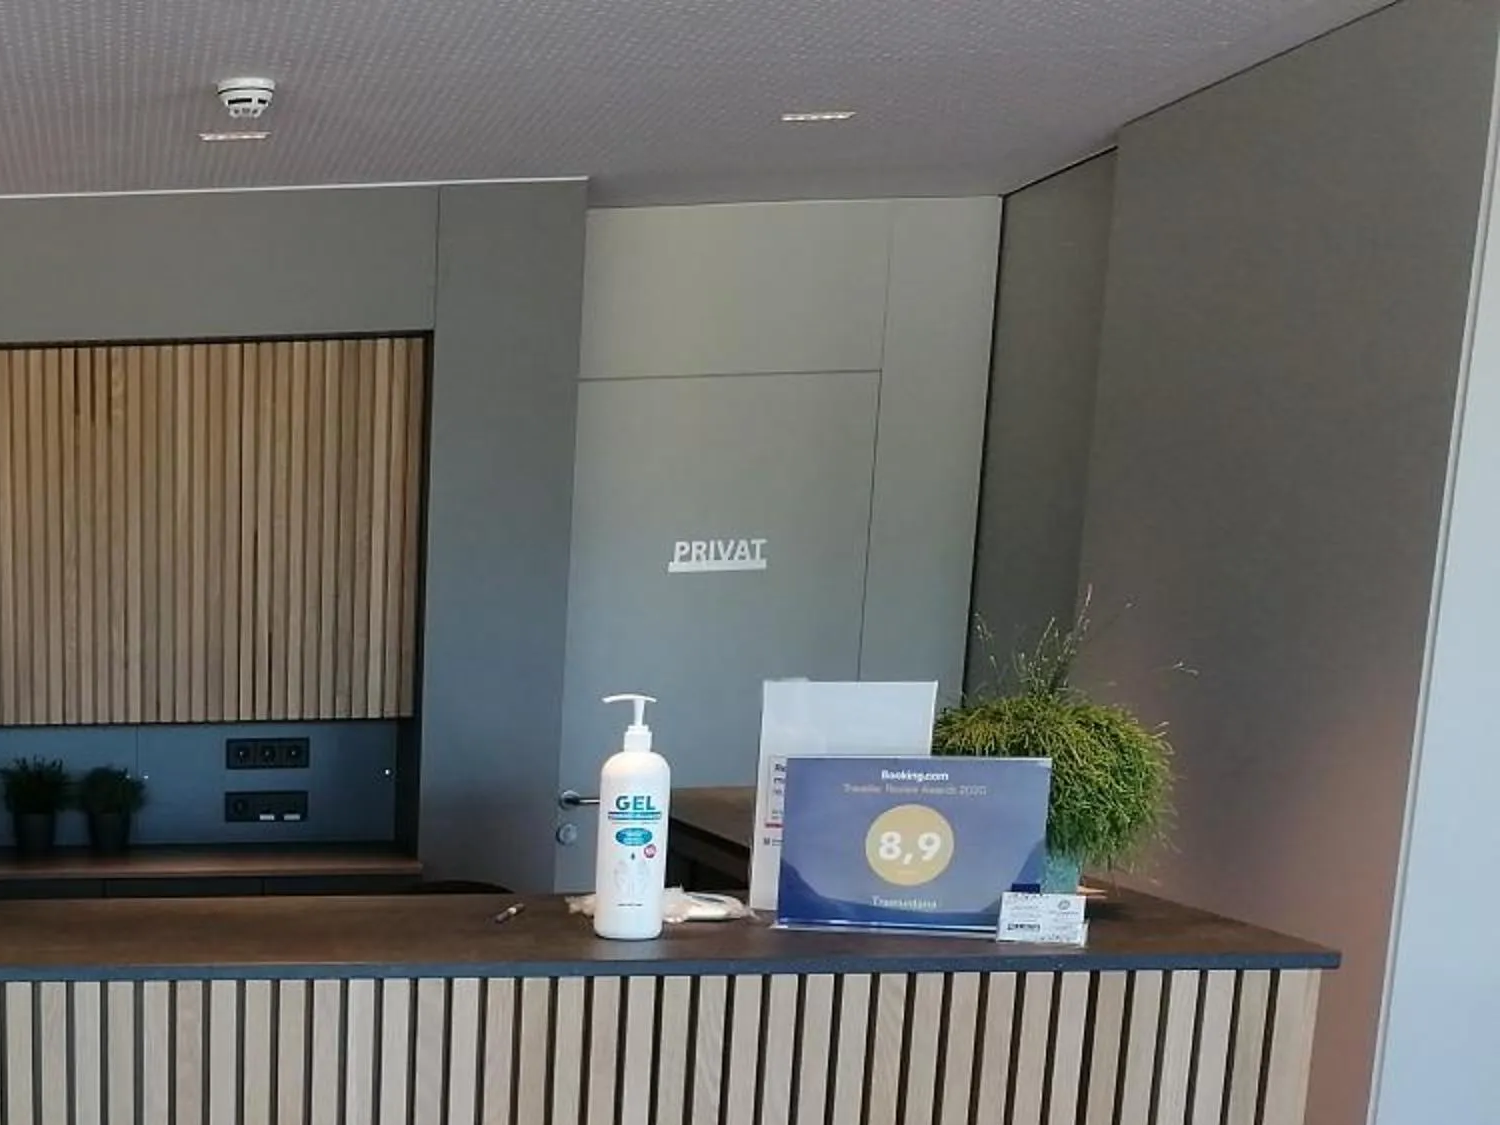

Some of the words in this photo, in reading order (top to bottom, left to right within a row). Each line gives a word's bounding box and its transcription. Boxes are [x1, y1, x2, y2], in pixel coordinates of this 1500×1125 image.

[674, 538, 768, 562] PRIVAT
[881, 769, 949, 783] Booking.com
[615, 795, 656, 811] GEL
[878, 831, 941, 865] 8,9
